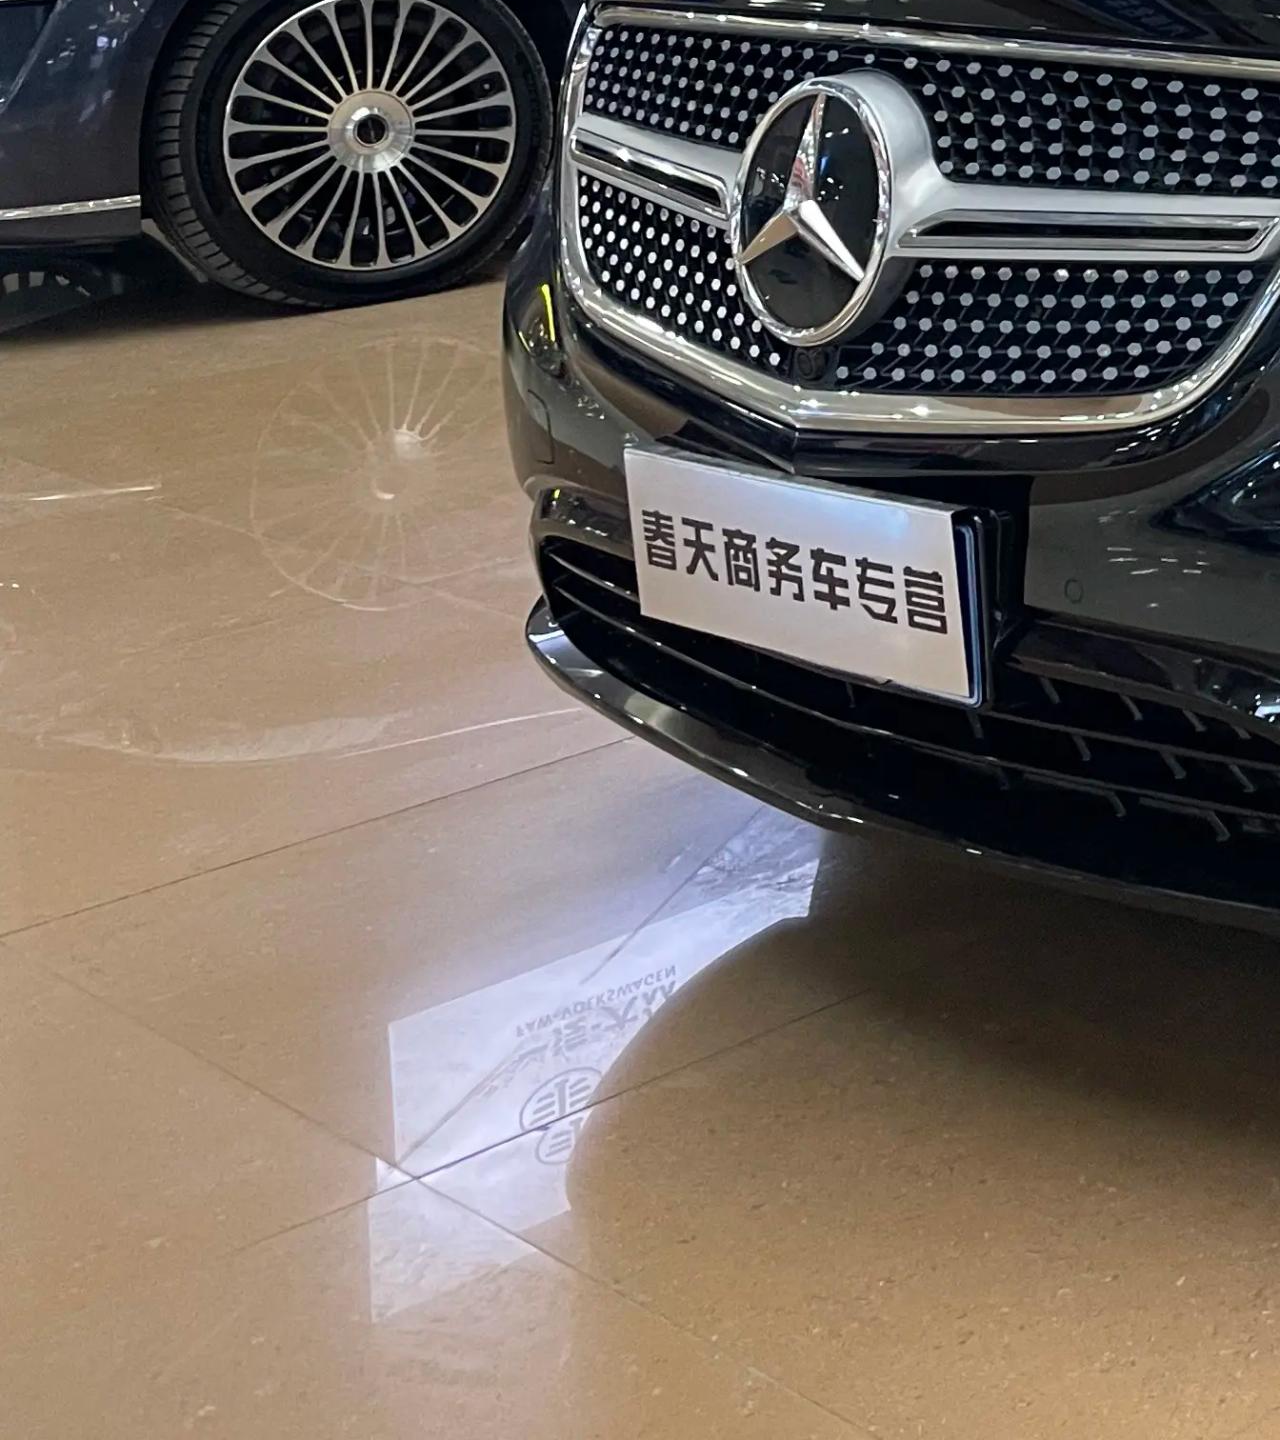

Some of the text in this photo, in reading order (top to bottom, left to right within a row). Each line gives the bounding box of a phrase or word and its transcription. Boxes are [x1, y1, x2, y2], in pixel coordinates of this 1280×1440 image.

[641, 509, 948, 635] 春天商务车专营
